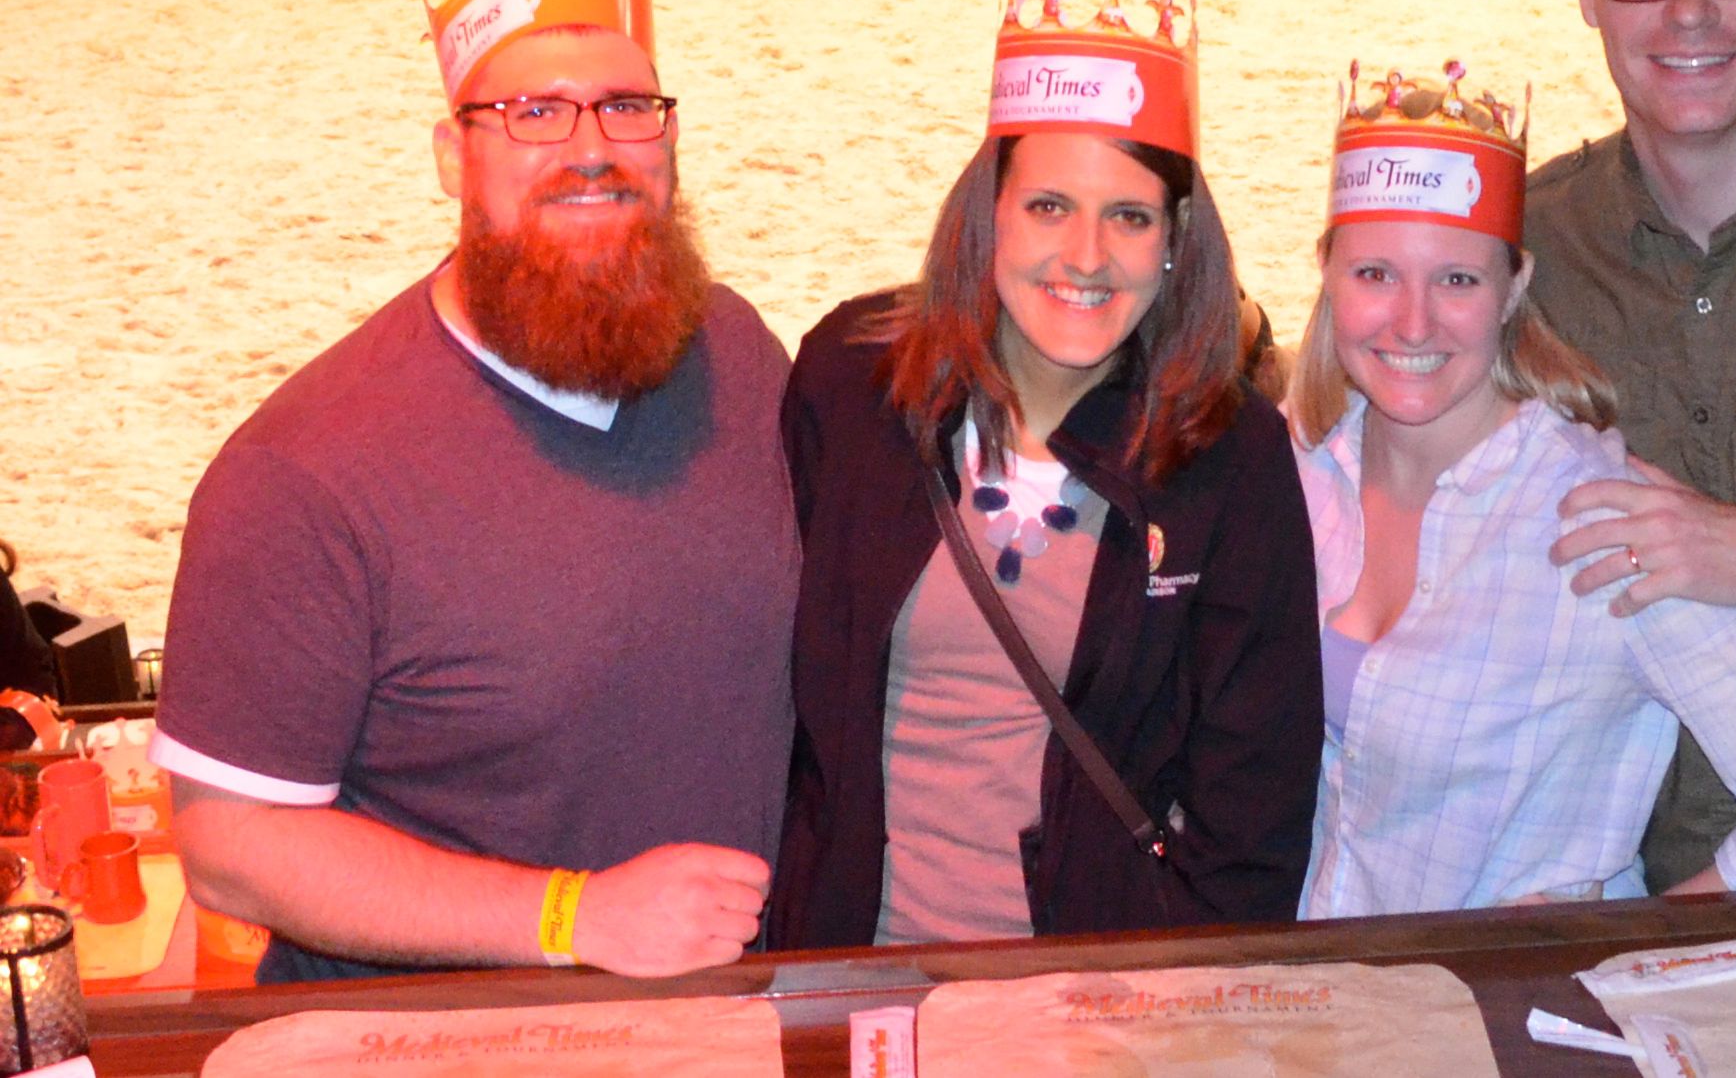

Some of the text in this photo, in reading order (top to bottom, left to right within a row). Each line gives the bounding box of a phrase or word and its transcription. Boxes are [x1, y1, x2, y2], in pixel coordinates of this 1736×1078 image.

[456, 3, 502, 45] Times
[1036, 67, 1101, 102] Times
[1376, 157, 1442, 190] Times
[1149, 573, 1200, 587] Pharmacy
[1228, 984, 1330, 1004] Times
